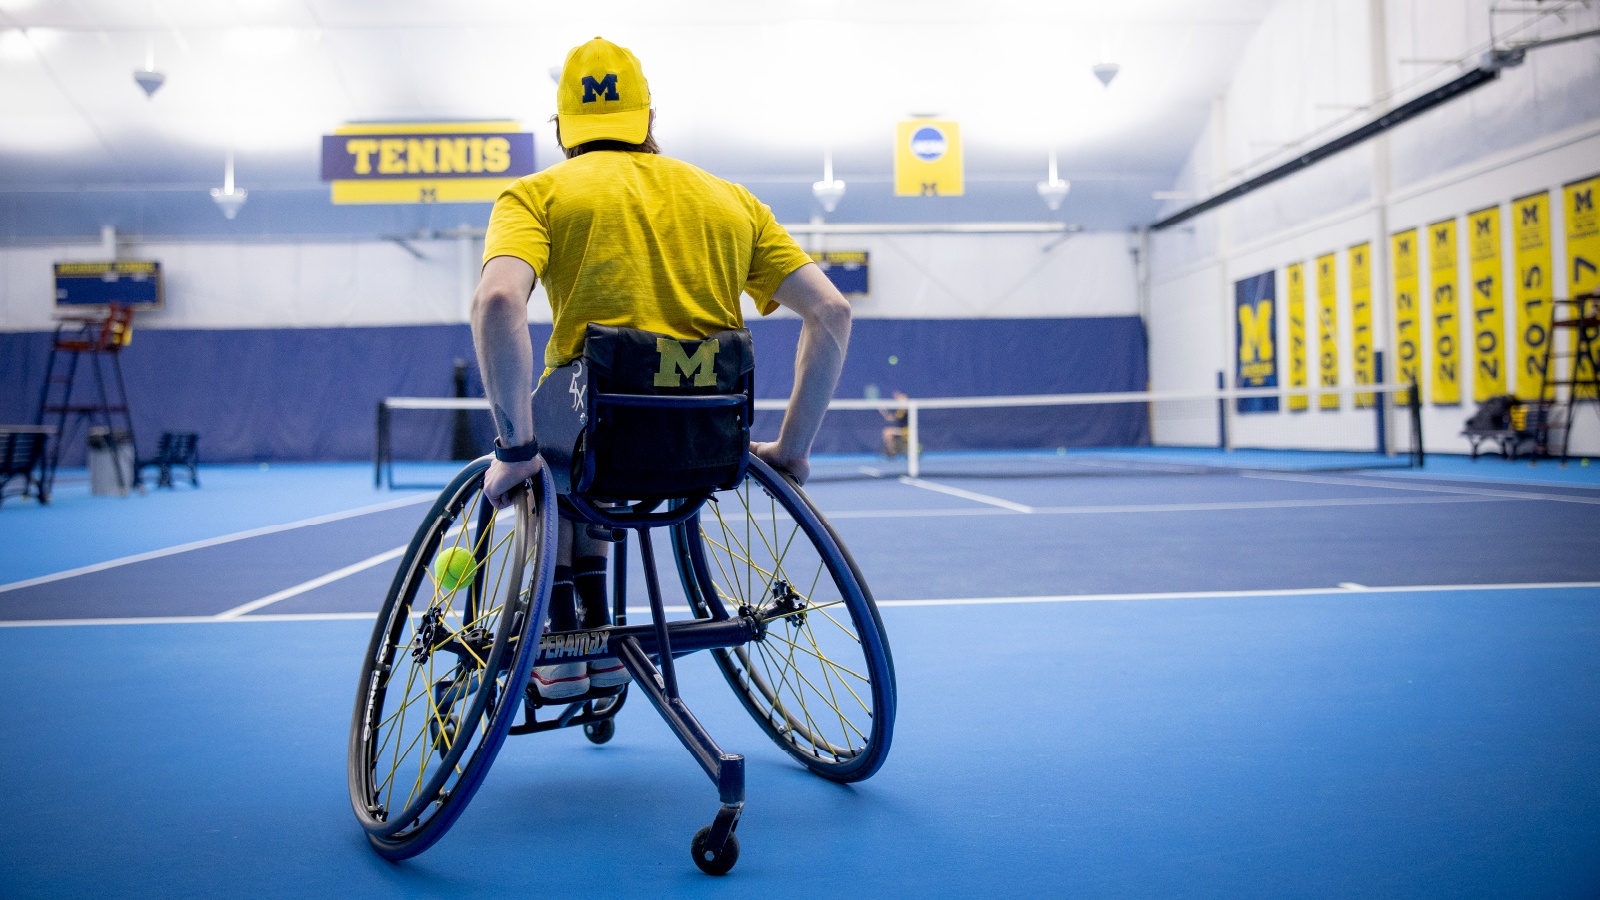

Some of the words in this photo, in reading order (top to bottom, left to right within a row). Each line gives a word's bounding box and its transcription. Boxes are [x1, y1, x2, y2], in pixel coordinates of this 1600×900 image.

[581, 73, 620, 104] M
[346, 137, 511, 175] TENNIS
[1521, 204, 1539, 225] M
[1573, 189, 1594, 213] M
[1435, 228, 1448, 244] M
[1476, 217, 1491, 236] M
[1238, 300, 1273, 363] M
[1398, 292, 1416, 385] 2012
[1435, 283, 1455, 382] 2013
[1475, 275, 1499, 380] 2014
[1523, 264, 1547, 377] 2015
[653, 337, 720, 388] M
